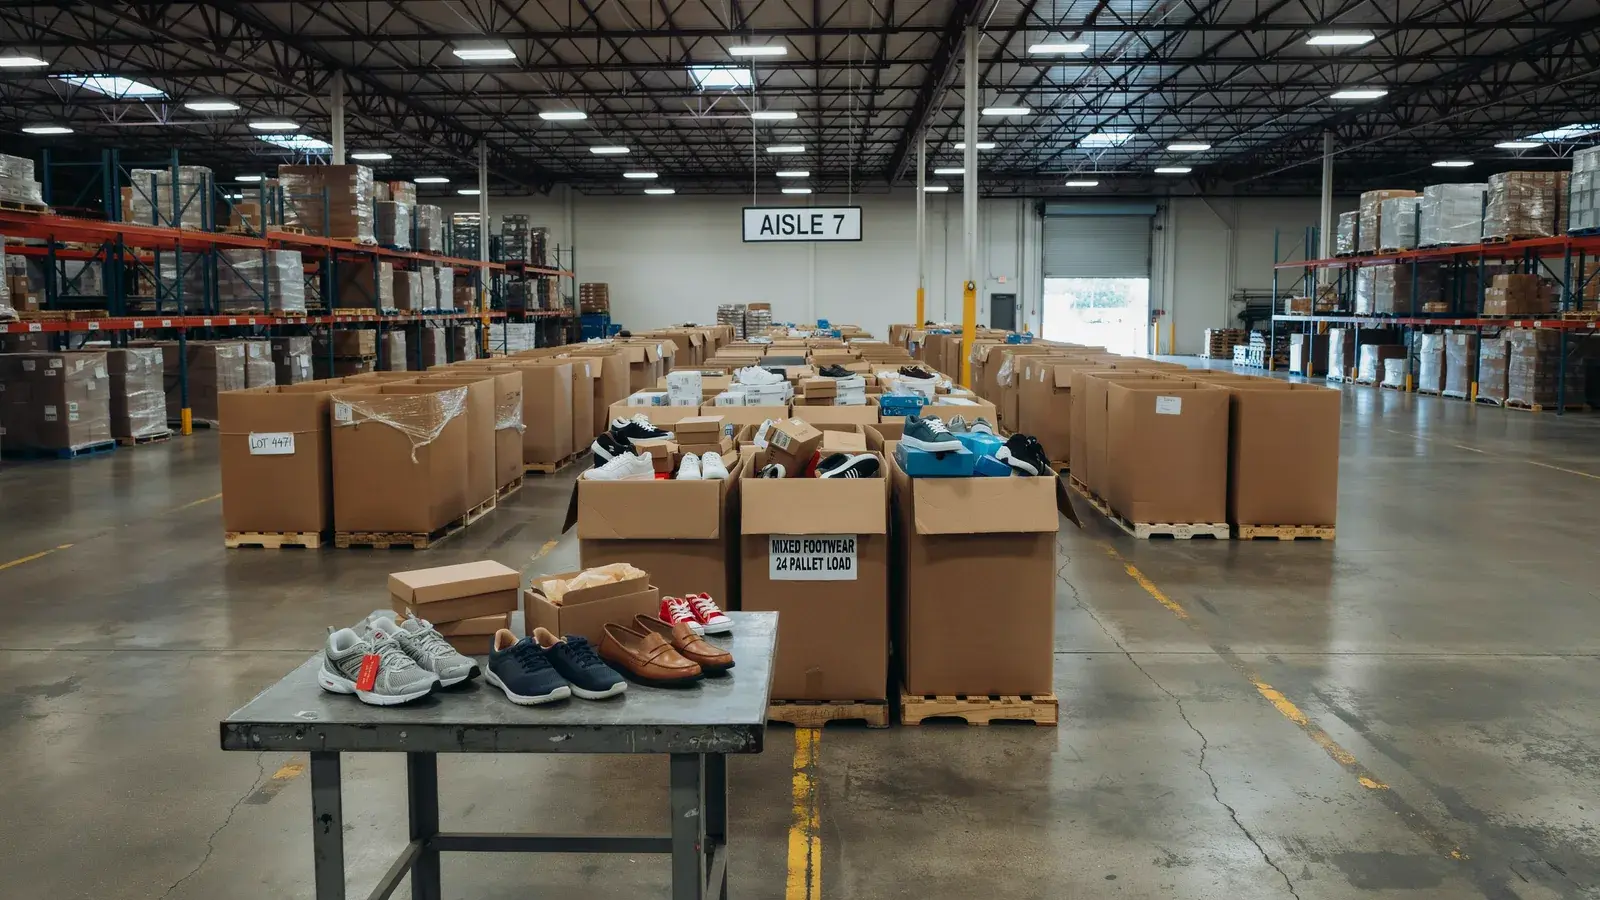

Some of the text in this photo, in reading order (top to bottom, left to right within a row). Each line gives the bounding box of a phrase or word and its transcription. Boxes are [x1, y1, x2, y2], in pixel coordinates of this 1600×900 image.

[760, 214, 845, 235] AISLE 7
[251, 437, 292, 449] LOT 4471
[772, 539, 854, 553] MIXED FOOTWEAR
[776, 557, 851, 570] 24 PALLET LOAD
